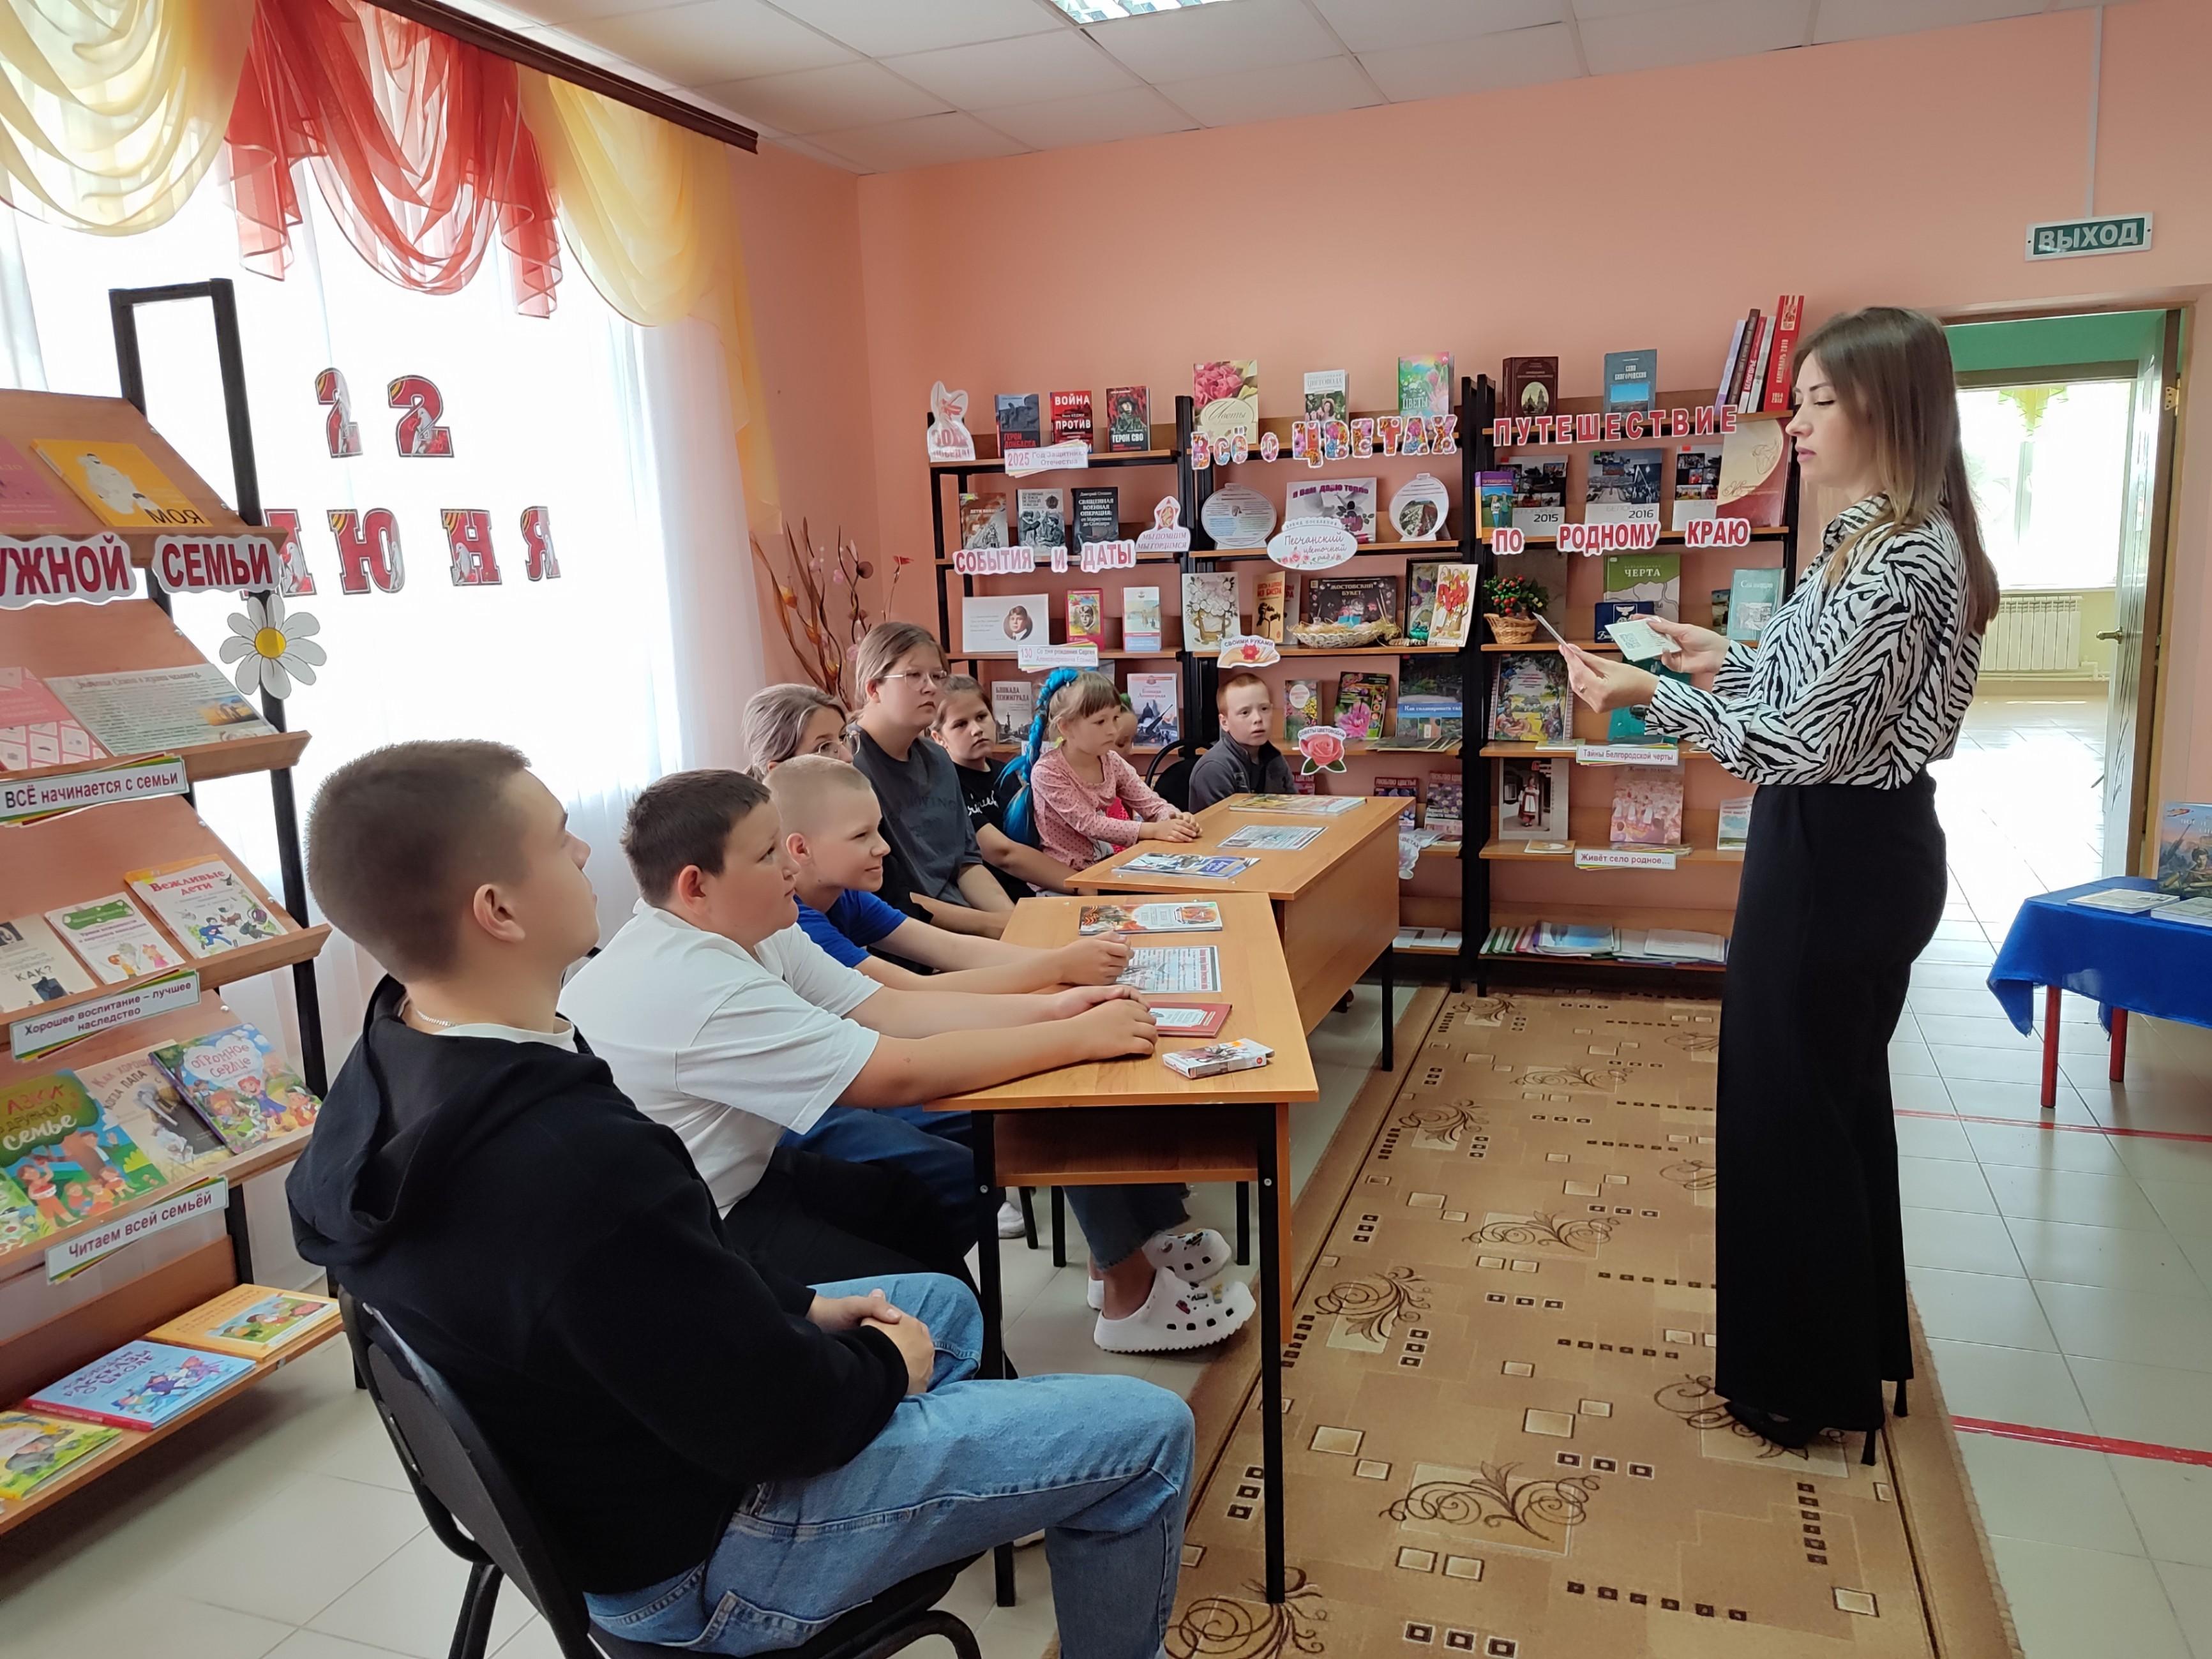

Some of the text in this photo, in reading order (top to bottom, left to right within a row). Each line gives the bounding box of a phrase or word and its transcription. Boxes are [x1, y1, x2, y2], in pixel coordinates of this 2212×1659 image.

[2038, 222, 2139, 251] ВЫХОД
[1055, 393, 1090, 405] ВОЙНА
[1403, 398, 1429, 409] ЦВЕТЫ
[315, 368, 455, 458] 22
[1055, 419, 1091, 430] ПРОТИВ
[1493, 405, 1738, 446] ПУТЕШЕСТВИЕ
[1112, 433, 1144, 443] ГЕРОИ СВО
[1292, 415, 1457, 468] ЦВЕТАХ
[1007, 453, 1030, 467] 2025
[144, 509, 205, 524] МОЯ
[1533, 514, 1559, 522] 2015
[1628, 509, 1654, 519] 2016
[1284, 532, 1344, 546] Песчанский
[1495, 521, 1749, 554] ПО РОДНОМУ КРАЮ
[1304, 544, 1346, 554] цветочный
[957, 543, 1132, 573] СОБЫТИЯ И ДАТЫ
[161, 543, 274, 588] СЕМЬИ
[1625, 569, 1660, 577] ЧЕРТА
[1224, 638, 1249, 647] СВОИМИ
[1021, 649, 1032, 658] 130
[1606, 750, 1651, 761] Белгородской
[1653, 753, 1673, 762] черты
[5, 770, 178, 808] ВСЁ начинается с семьи
[1581, 853, 1607, 862] Живёт
[1631, 855, 1670, 866] родное...
[149, 871, 225, 892] Вежливые
[15, 965, 52, 982] КАК?
[25, 1014, 75, 1036] Хорошее
[78, 996, 140, 1019] воспитание
[153, 982, 192, 999] лучшее
[78, 1007, 140, 1031] наследство
[68, 1192, 213, 1259] Читаем всей семьёй
